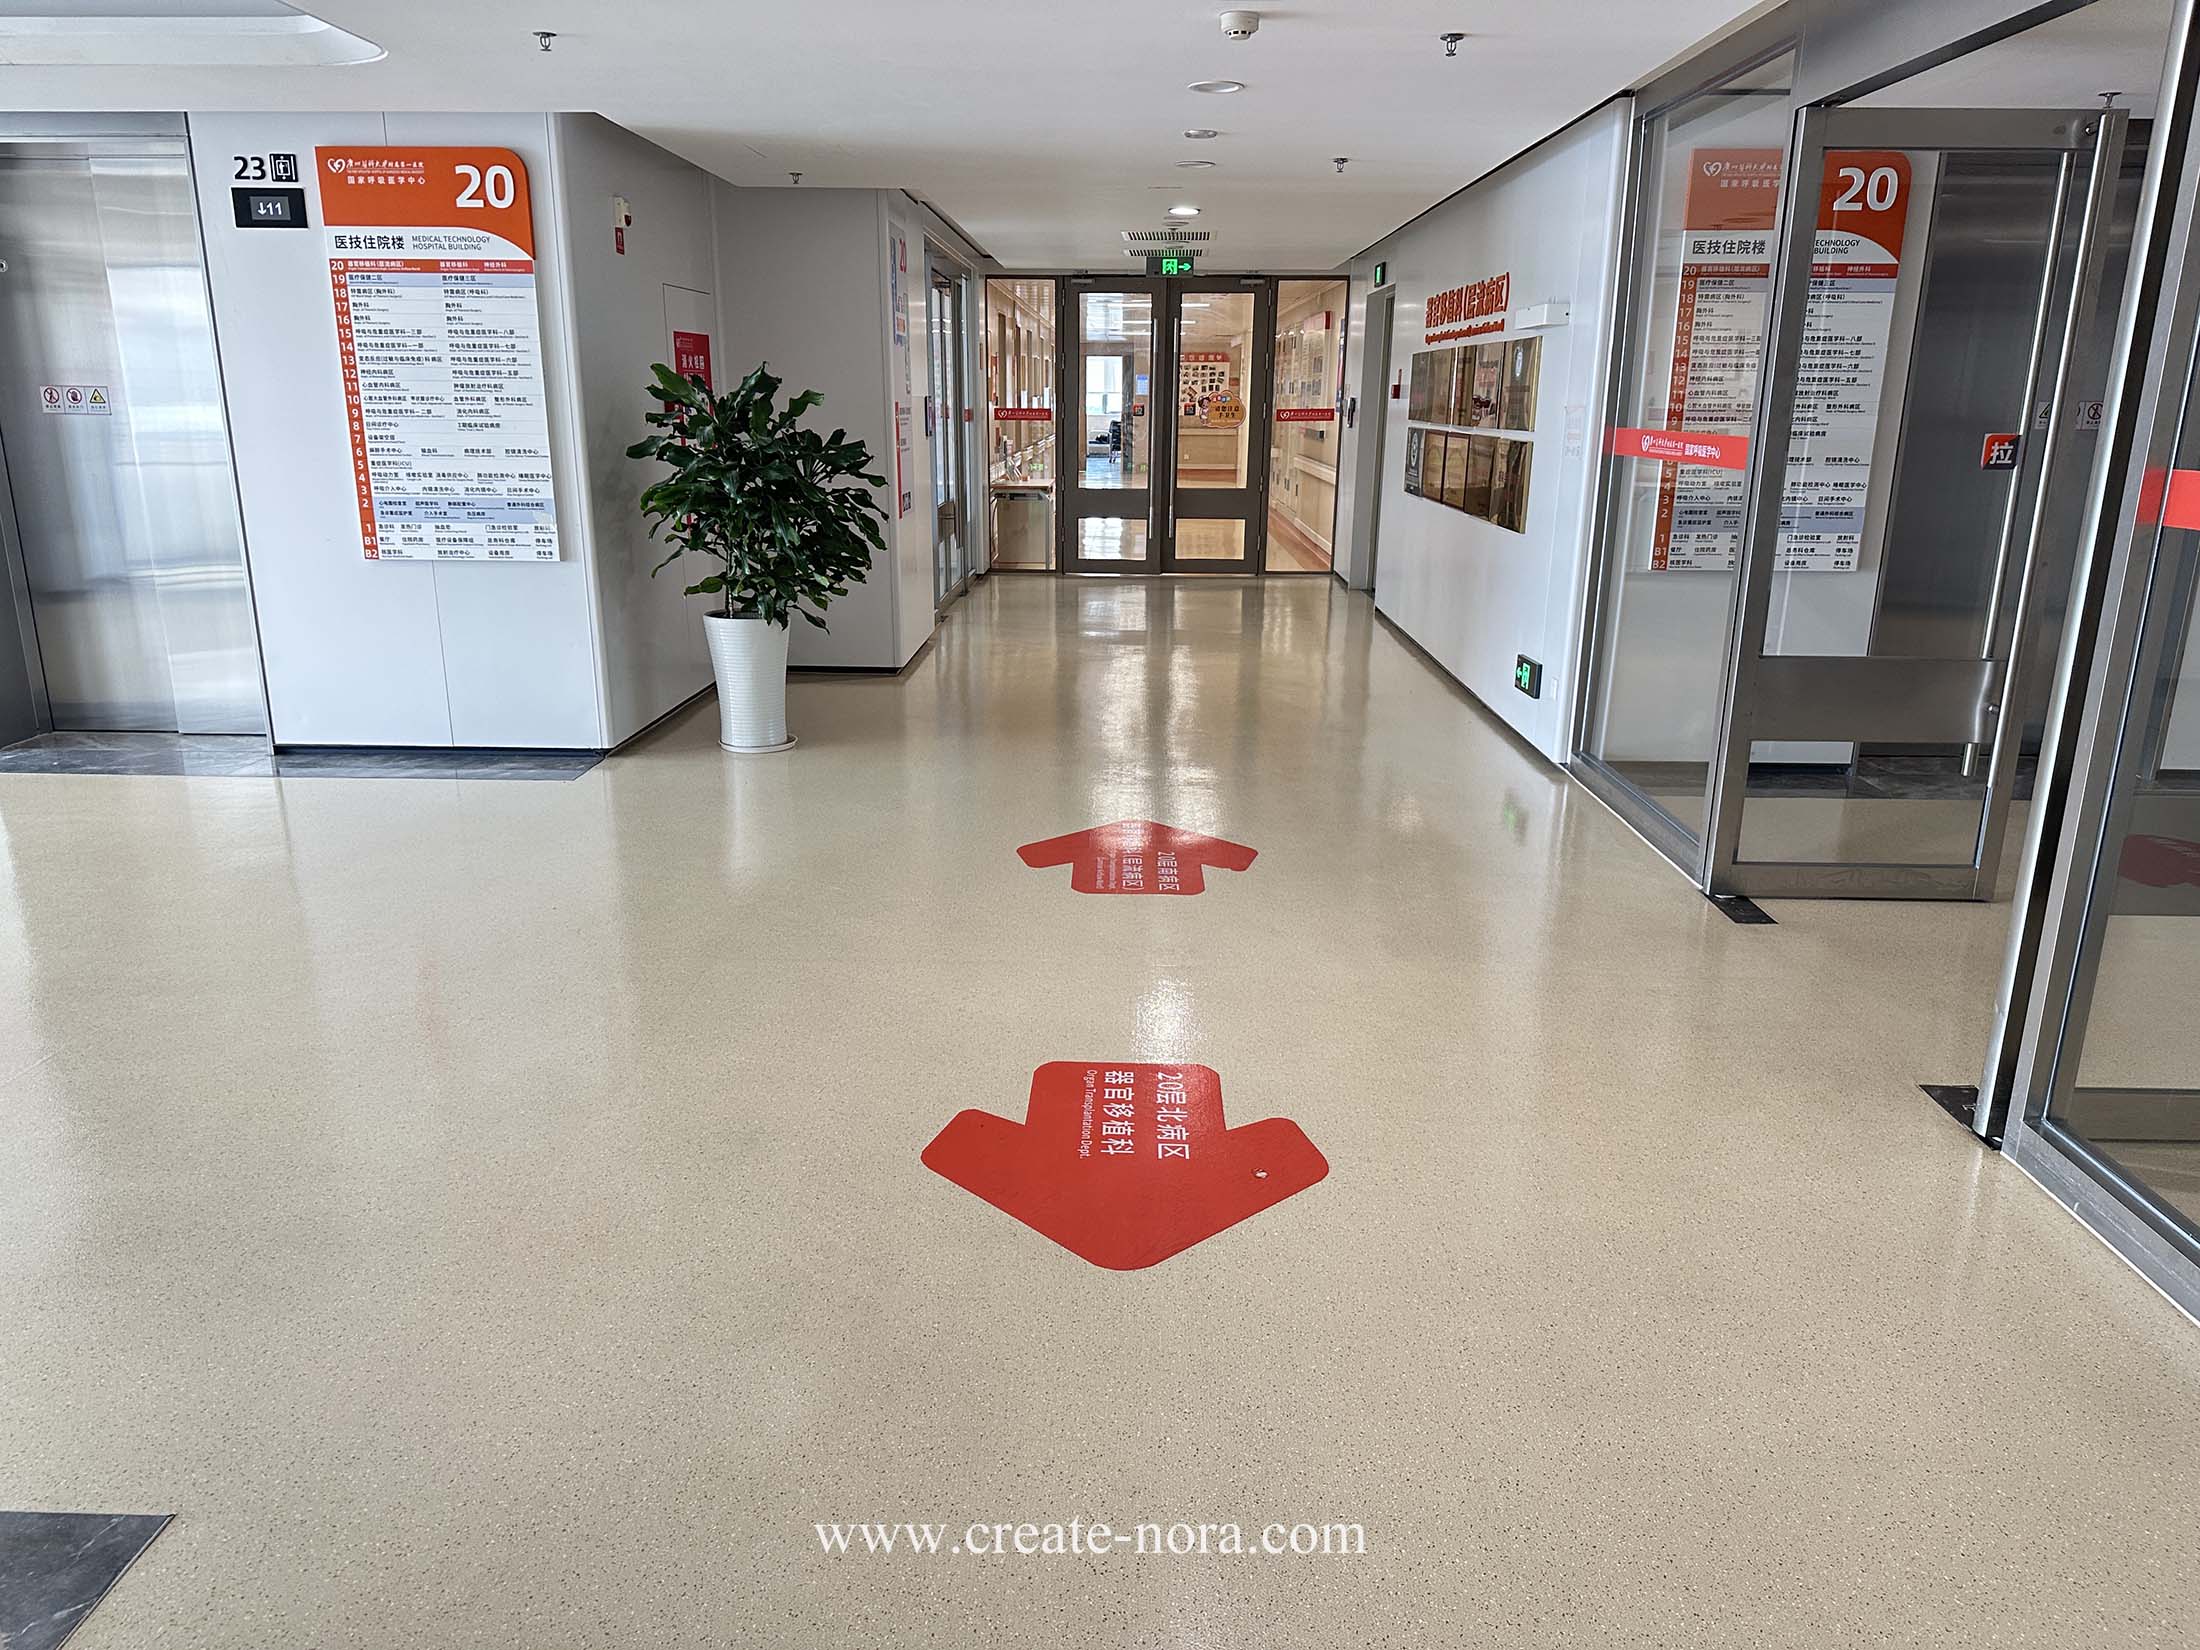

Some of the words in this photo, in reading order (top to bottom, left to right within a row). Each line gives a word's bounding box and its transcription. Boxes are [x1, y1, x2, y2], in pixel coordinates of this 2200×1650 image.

[234, 156, 266, 180] 23
[454, 164, 515, 209] 20
[1833, 167, 1898, 211] 20
[267, 202, 282, 215] 11
[334, 235, 405, 250] 医技住院楼
[412, 235, 443, 243] MEDICAL
[444, 236, 490, 244] TECHNOLOGY
[448, 243, 482, 251] BUILDING
[1693, 240, 1766, 255] 医技住院楼
[331, 261, 344, 271] 20
[1684, 266, 1697, 275] 20
[333, 275, 345, 284] 19
[1683, 280, 1695, 289] 19
[334, 288, 346, 298] 18
[1682, 294, 1694, 303] 18
[336, 302, 348, 312] 17
[1680, 308, 1692, 317] 17
[337, 316, 350, 325] 16
[1678, 322, 1690, 331] 16
[338, 329, 351, 338] 15
[1677, 335, 1689, 344] 15
[340, 342, 353, 351] 14
[1676, 350, 1688, 358] 14
[342, 356, 354, 365] 13
[343, 370, 357, 378] 12
[1673, 376, 1685, 385] 12
[345, 382, 358, 391] 11
[347, 395, 360, 405] 10
[1670, 403, 1682, 412] 10
[352, 409, 359, 418] 9
[1672, 416, 1678, 426] 9
[353, 422, 359, 431] 8
[354, 435, 360, 444] 7
[356, 448, 363, 457] 6
[1989, 441, 2014, 464] 拉
[357, 461, 364, 469] 5
[358, 473, 366, 482] 4
[361, 486, 367, 495] 3
[362, 499, 369, 508] 2
[1664, 496, 1669, 504] 3
[1661, 509, 1668, 518] 2
[366, 523, 371, 532] 1
[365, 537, 377, 545] B1
[365, 550, 379, 559] B2
[1655, 548, 1667, 556] B1
[1653, 560, 1666, 569] B2
[1157, 851, 1180, 891] 20层南病区
[1083, 1069, 1098, 1088] Organ
[1081, 1088, 1096, 1137] Transplantation
[1100, 1070, 1135, 1155] 器官移植科
[1156, 1072, 1190, 1160] 20层北病区
[1076, 1140, 1093, 1159] Dept.
